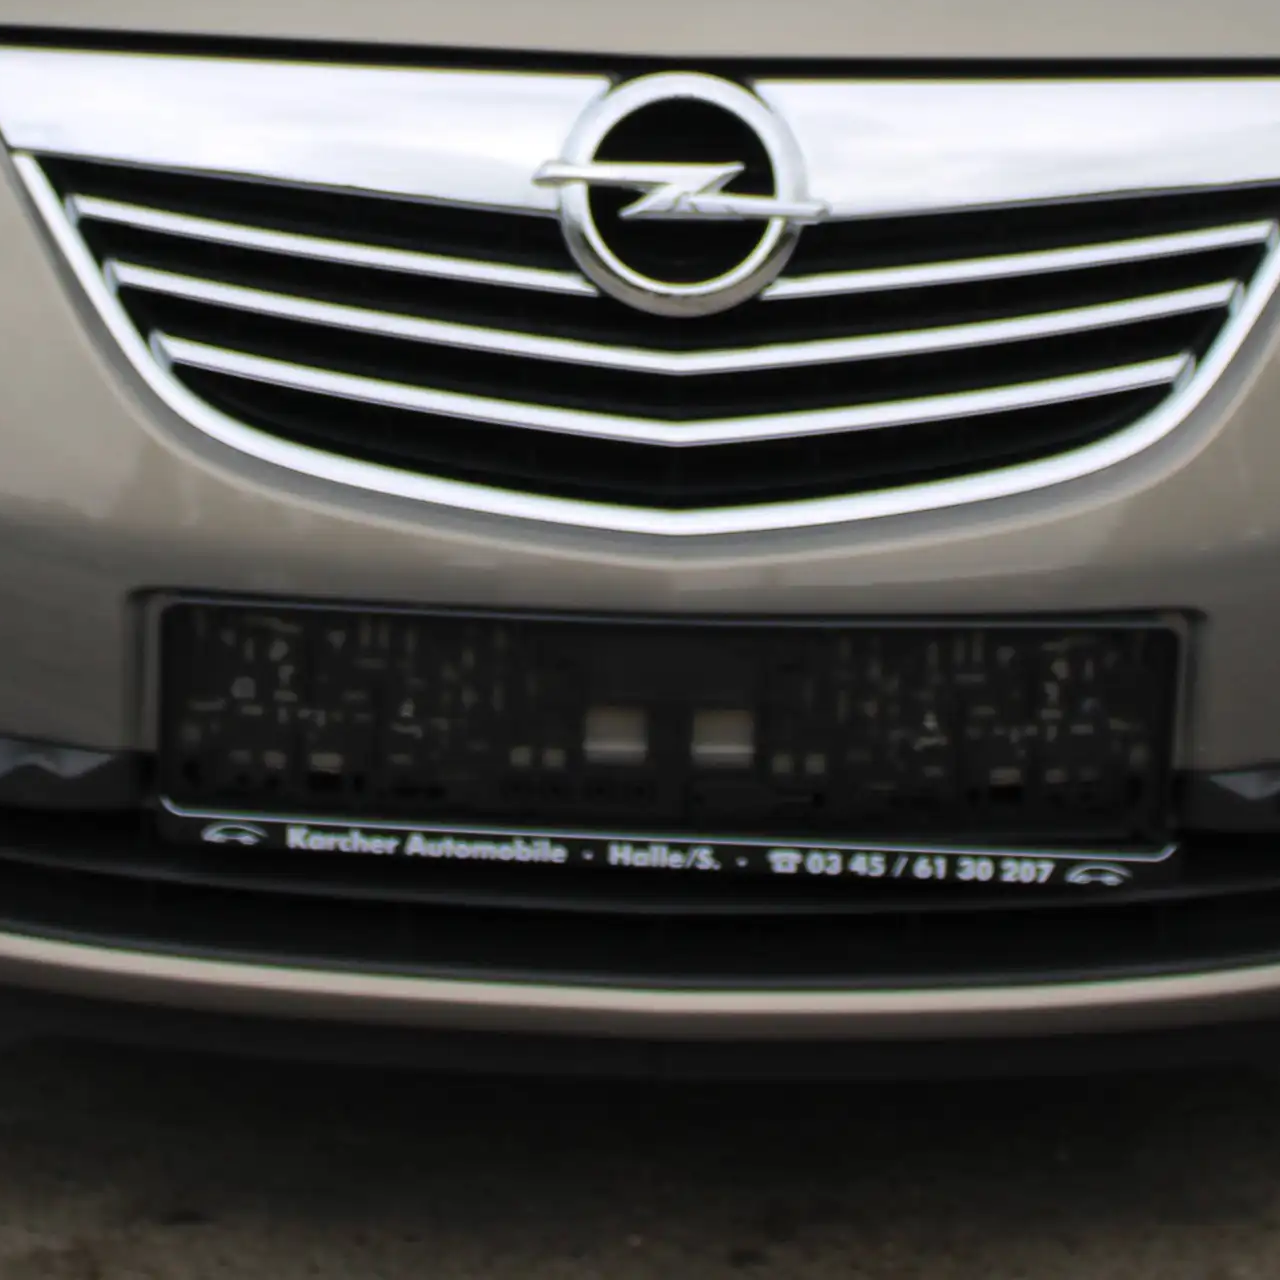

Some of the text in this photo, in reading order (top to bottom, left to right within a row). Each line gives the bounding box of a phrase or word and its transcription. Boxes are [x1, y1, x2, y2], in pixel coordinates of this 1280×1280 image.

[286, 824, 1055, 884] Karcher Automobile Halle/S. 03 45 / 61 30 207
